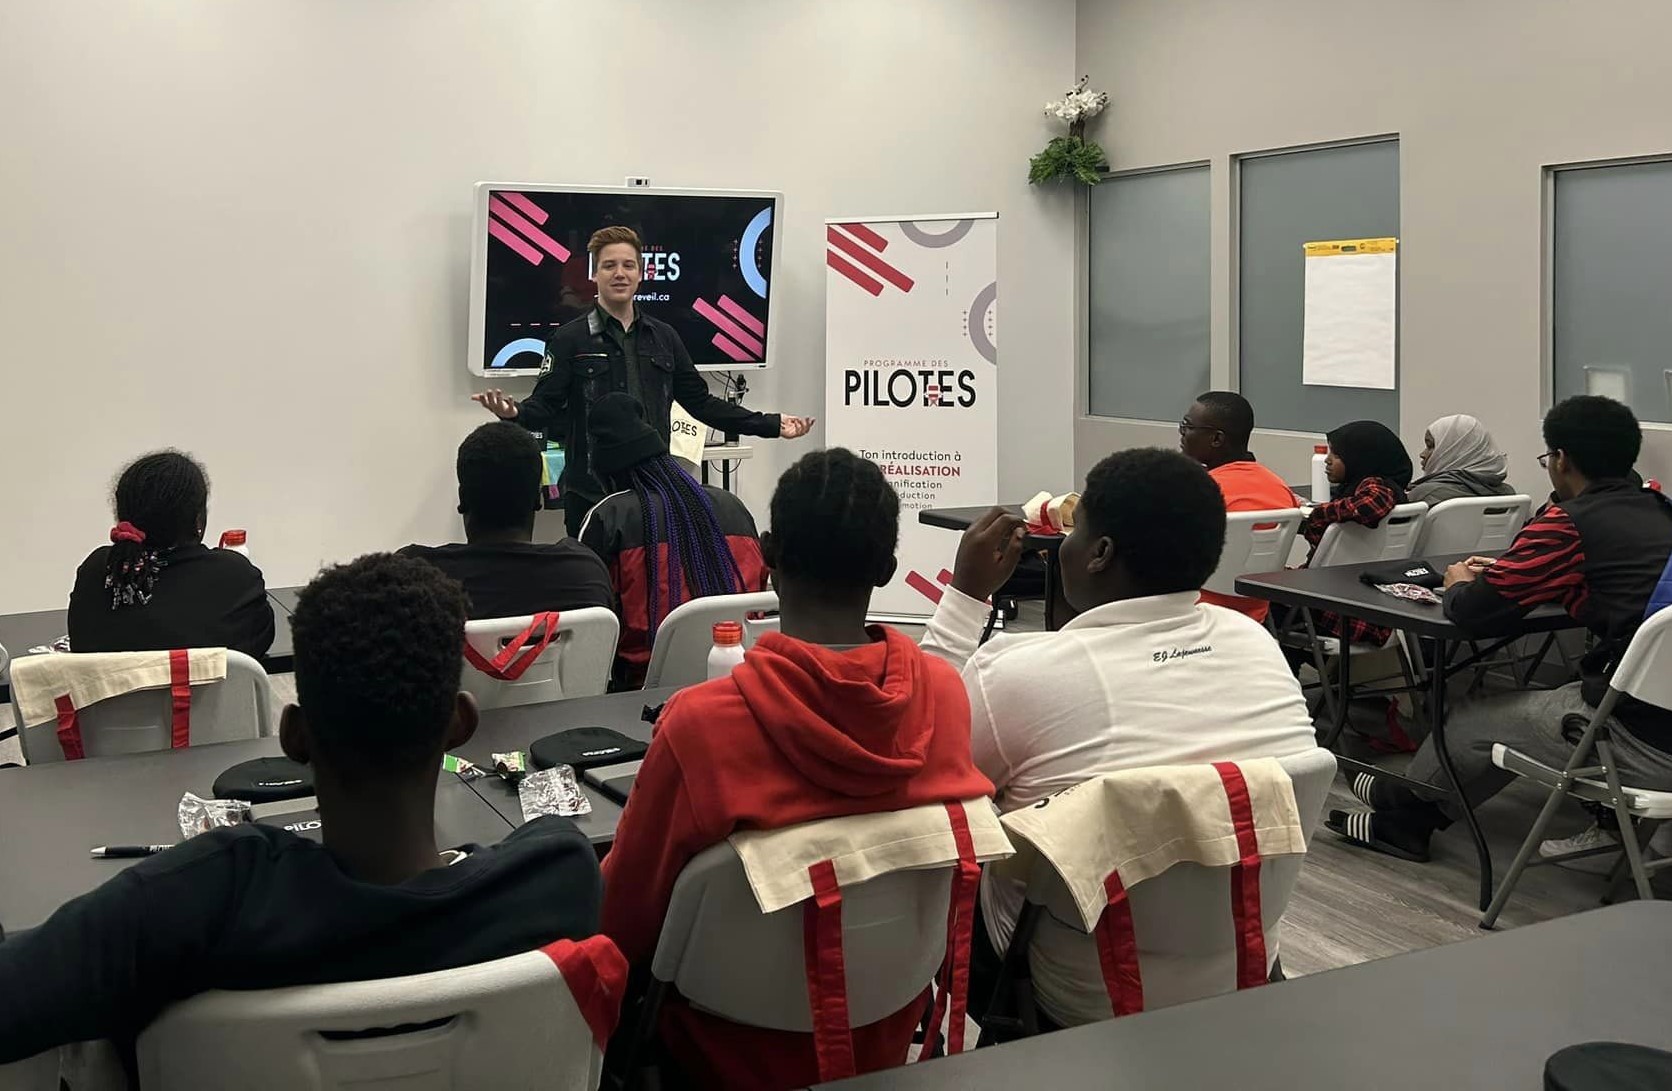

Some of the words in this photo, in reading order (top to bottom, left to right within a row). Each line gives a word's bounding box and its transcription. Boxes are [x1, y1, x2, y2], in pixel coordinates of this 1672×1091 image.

[632, 291, 670, 301] reveil.ca
[863, 359, 927, 367] PROGRAMME
[844, 369, 976, 408] PILOTES
[859, 449, 879, 460] Ton
[882, 449, 951, 461] introduction
[954, 450, 961, 461] à
[880, 461, 960, 477] RÉALISATION
[899, 491, 936, 500] duction
